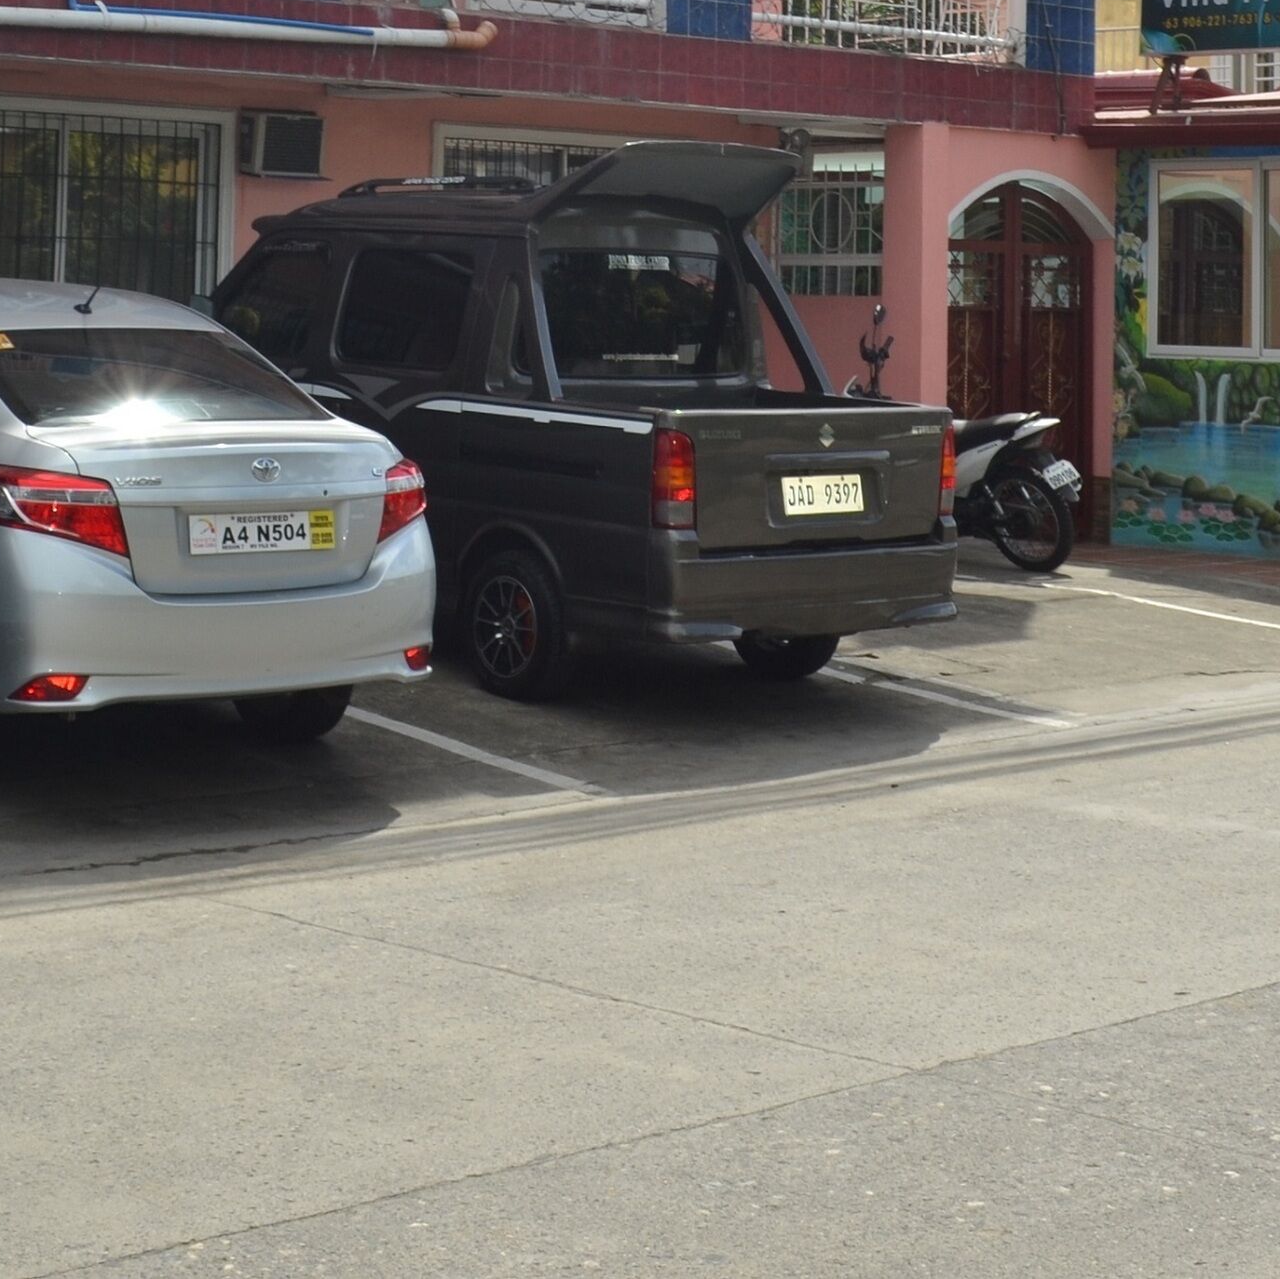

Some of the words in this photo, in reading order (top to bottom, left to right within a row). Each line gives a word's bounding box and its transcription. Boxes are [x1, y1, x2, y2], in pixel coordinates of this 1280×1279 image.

[788, 484, 815, 506] JAD
[825, 483, 859, 505] 9397
[236, 515, 289, 523] REGISTERED
[222, 526, 249, 545] A4
[257, 523, 307, 542] N504
